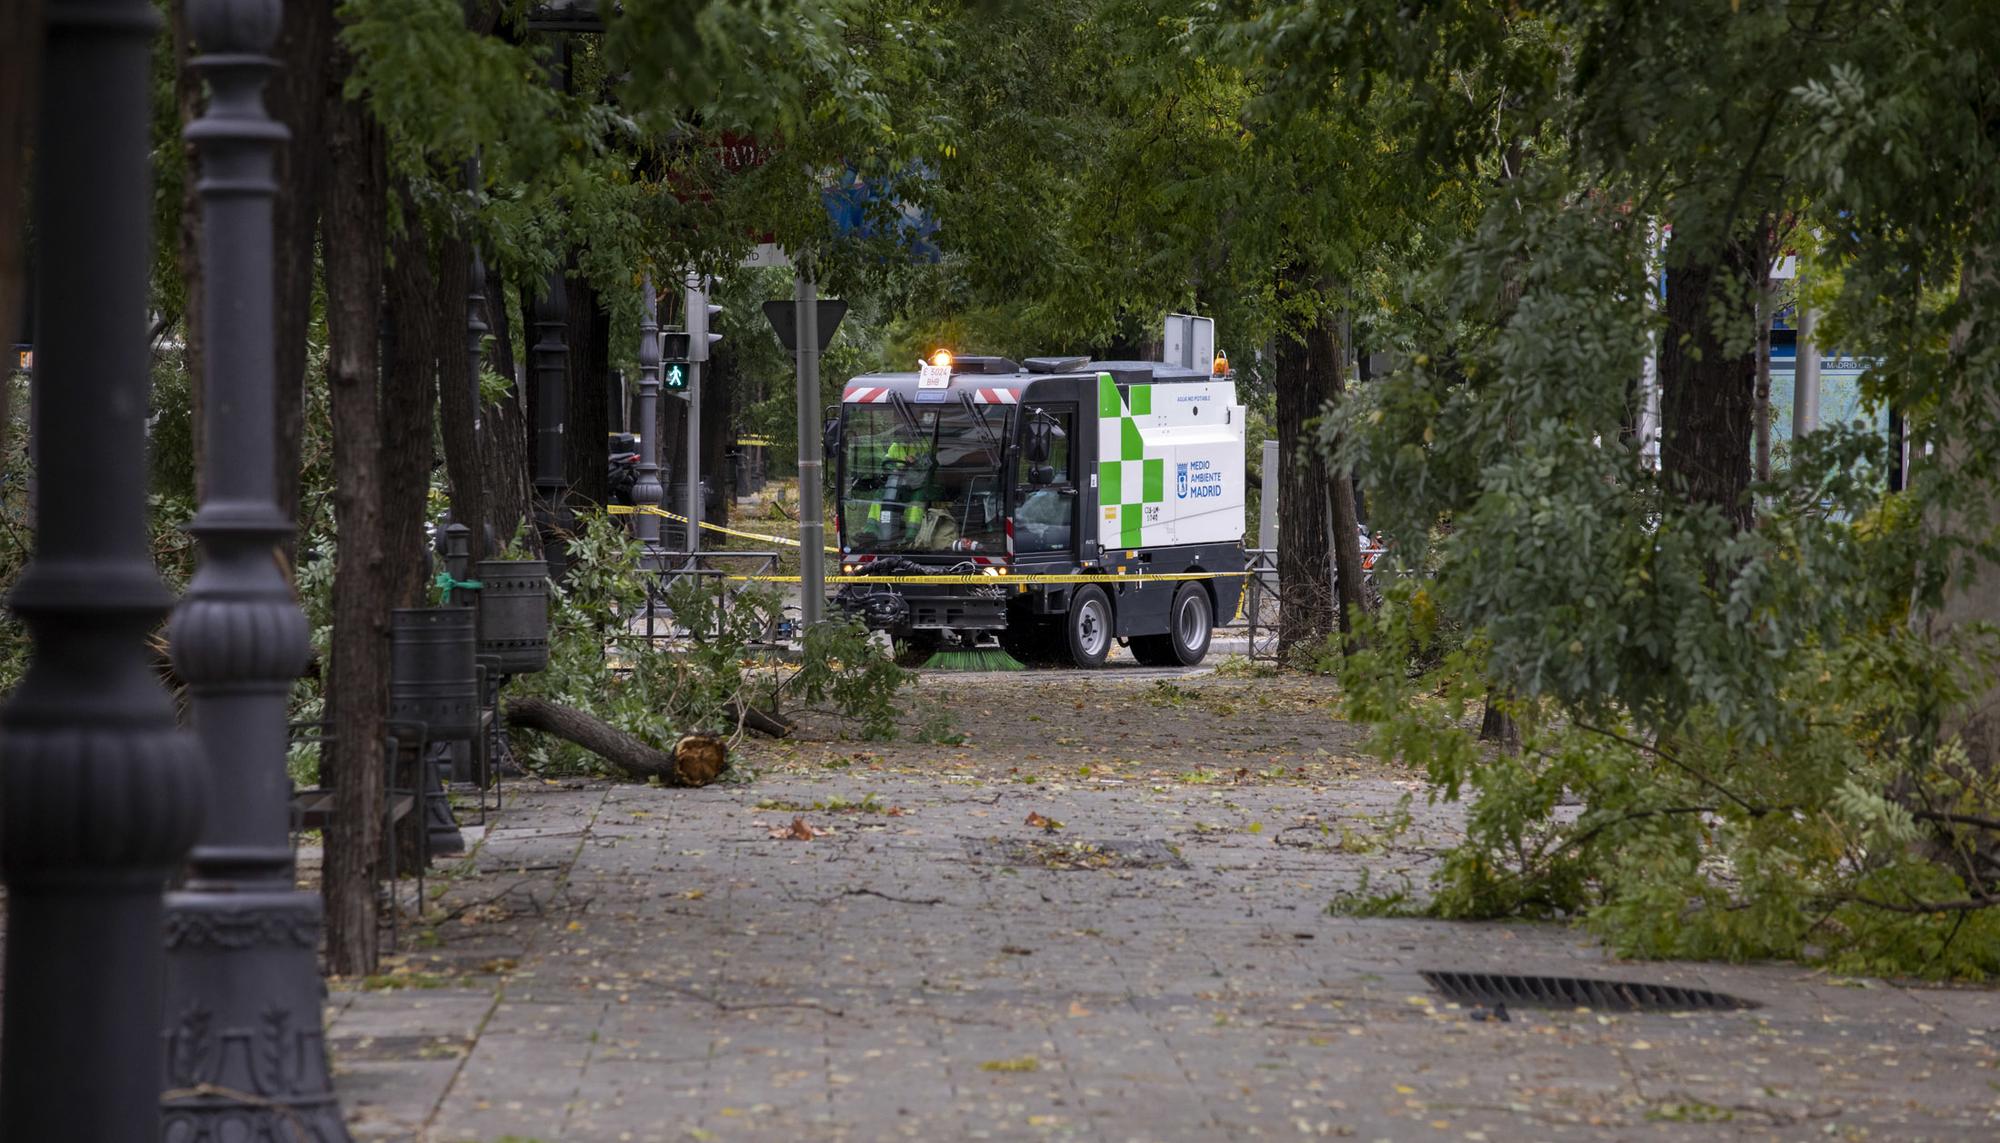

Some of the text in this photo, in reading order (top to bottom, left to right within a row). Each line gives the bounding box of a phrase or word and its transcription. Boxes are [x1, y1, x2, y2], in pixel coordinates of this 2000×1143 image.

[1190, 460, 1210, 470] MEDIO
[1190, 472, 1222, 483] AMBIENTE
[1190, 485, 1222, 499] MADRID
